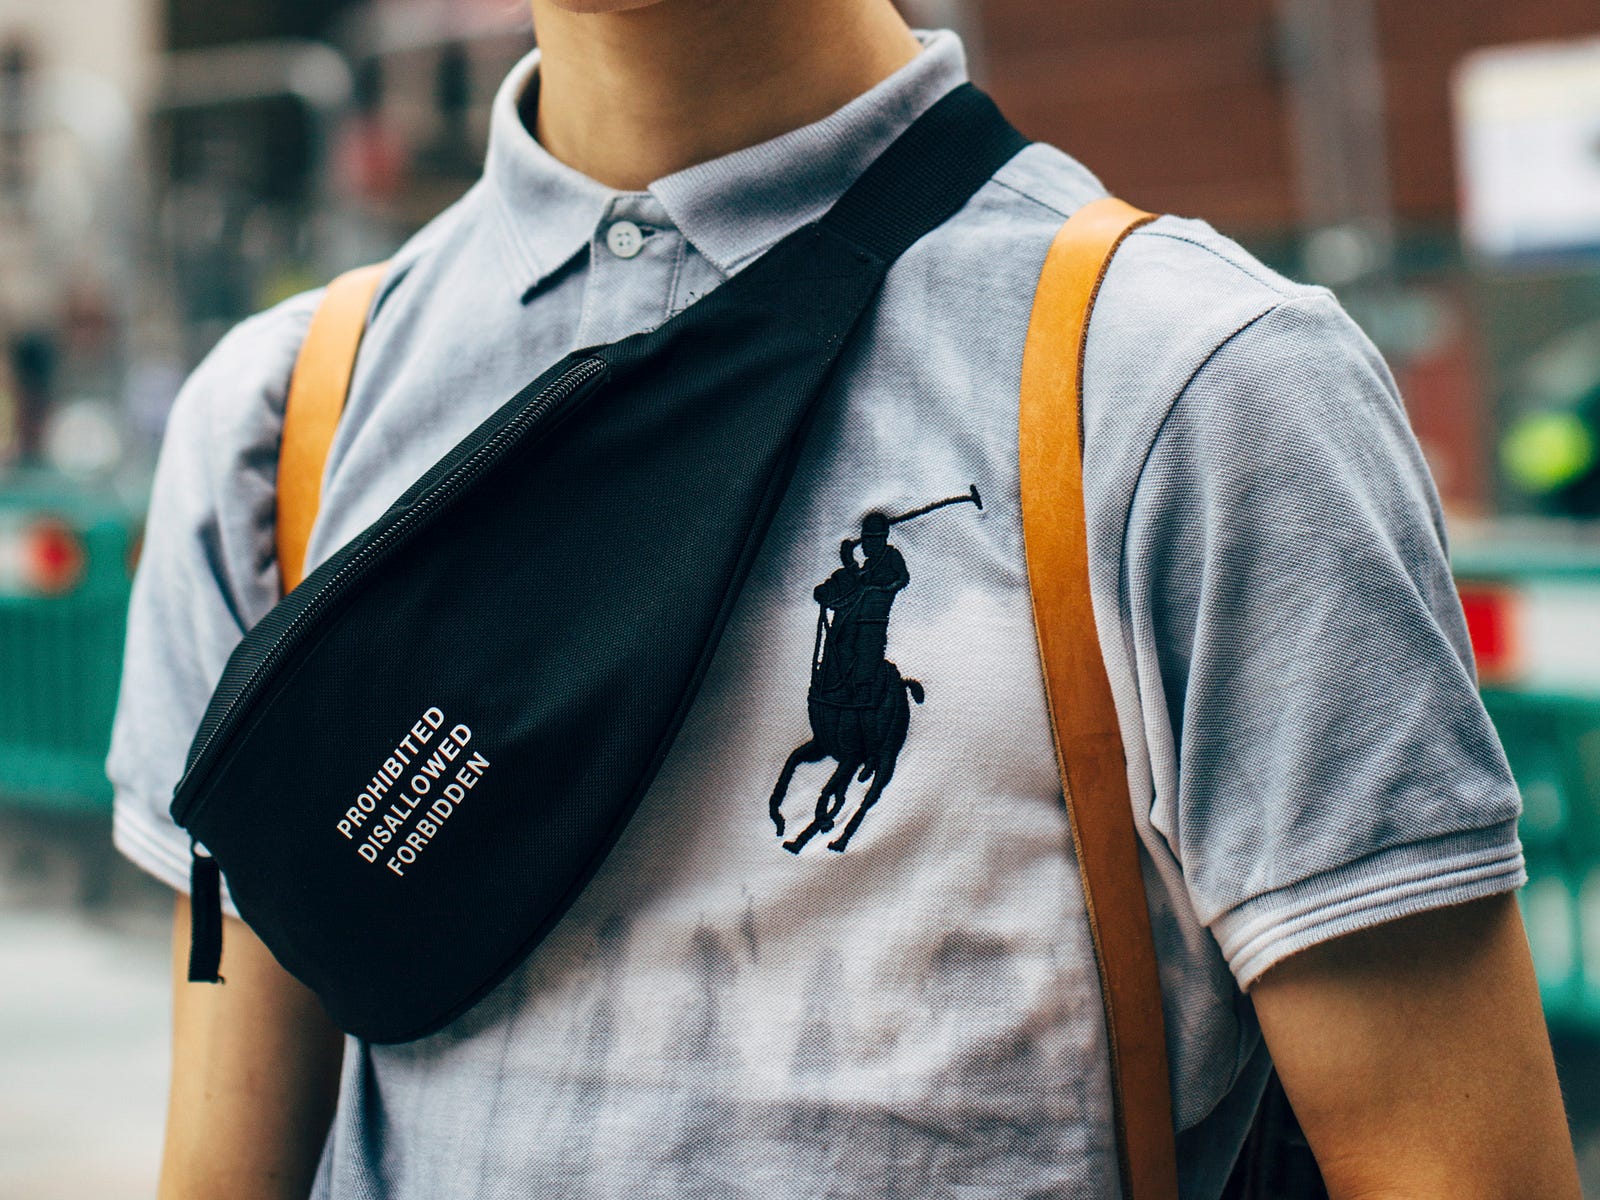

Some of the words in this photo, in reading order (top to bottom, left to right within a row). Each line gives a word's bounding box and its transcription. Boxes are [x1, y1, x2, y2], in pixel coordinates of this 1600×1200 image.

[336, 706, 445, 840] PROHIBITED
[357, 723, 472, 864] DISALLOWED
[386, 751, 491, 877] FORBIDDEN
